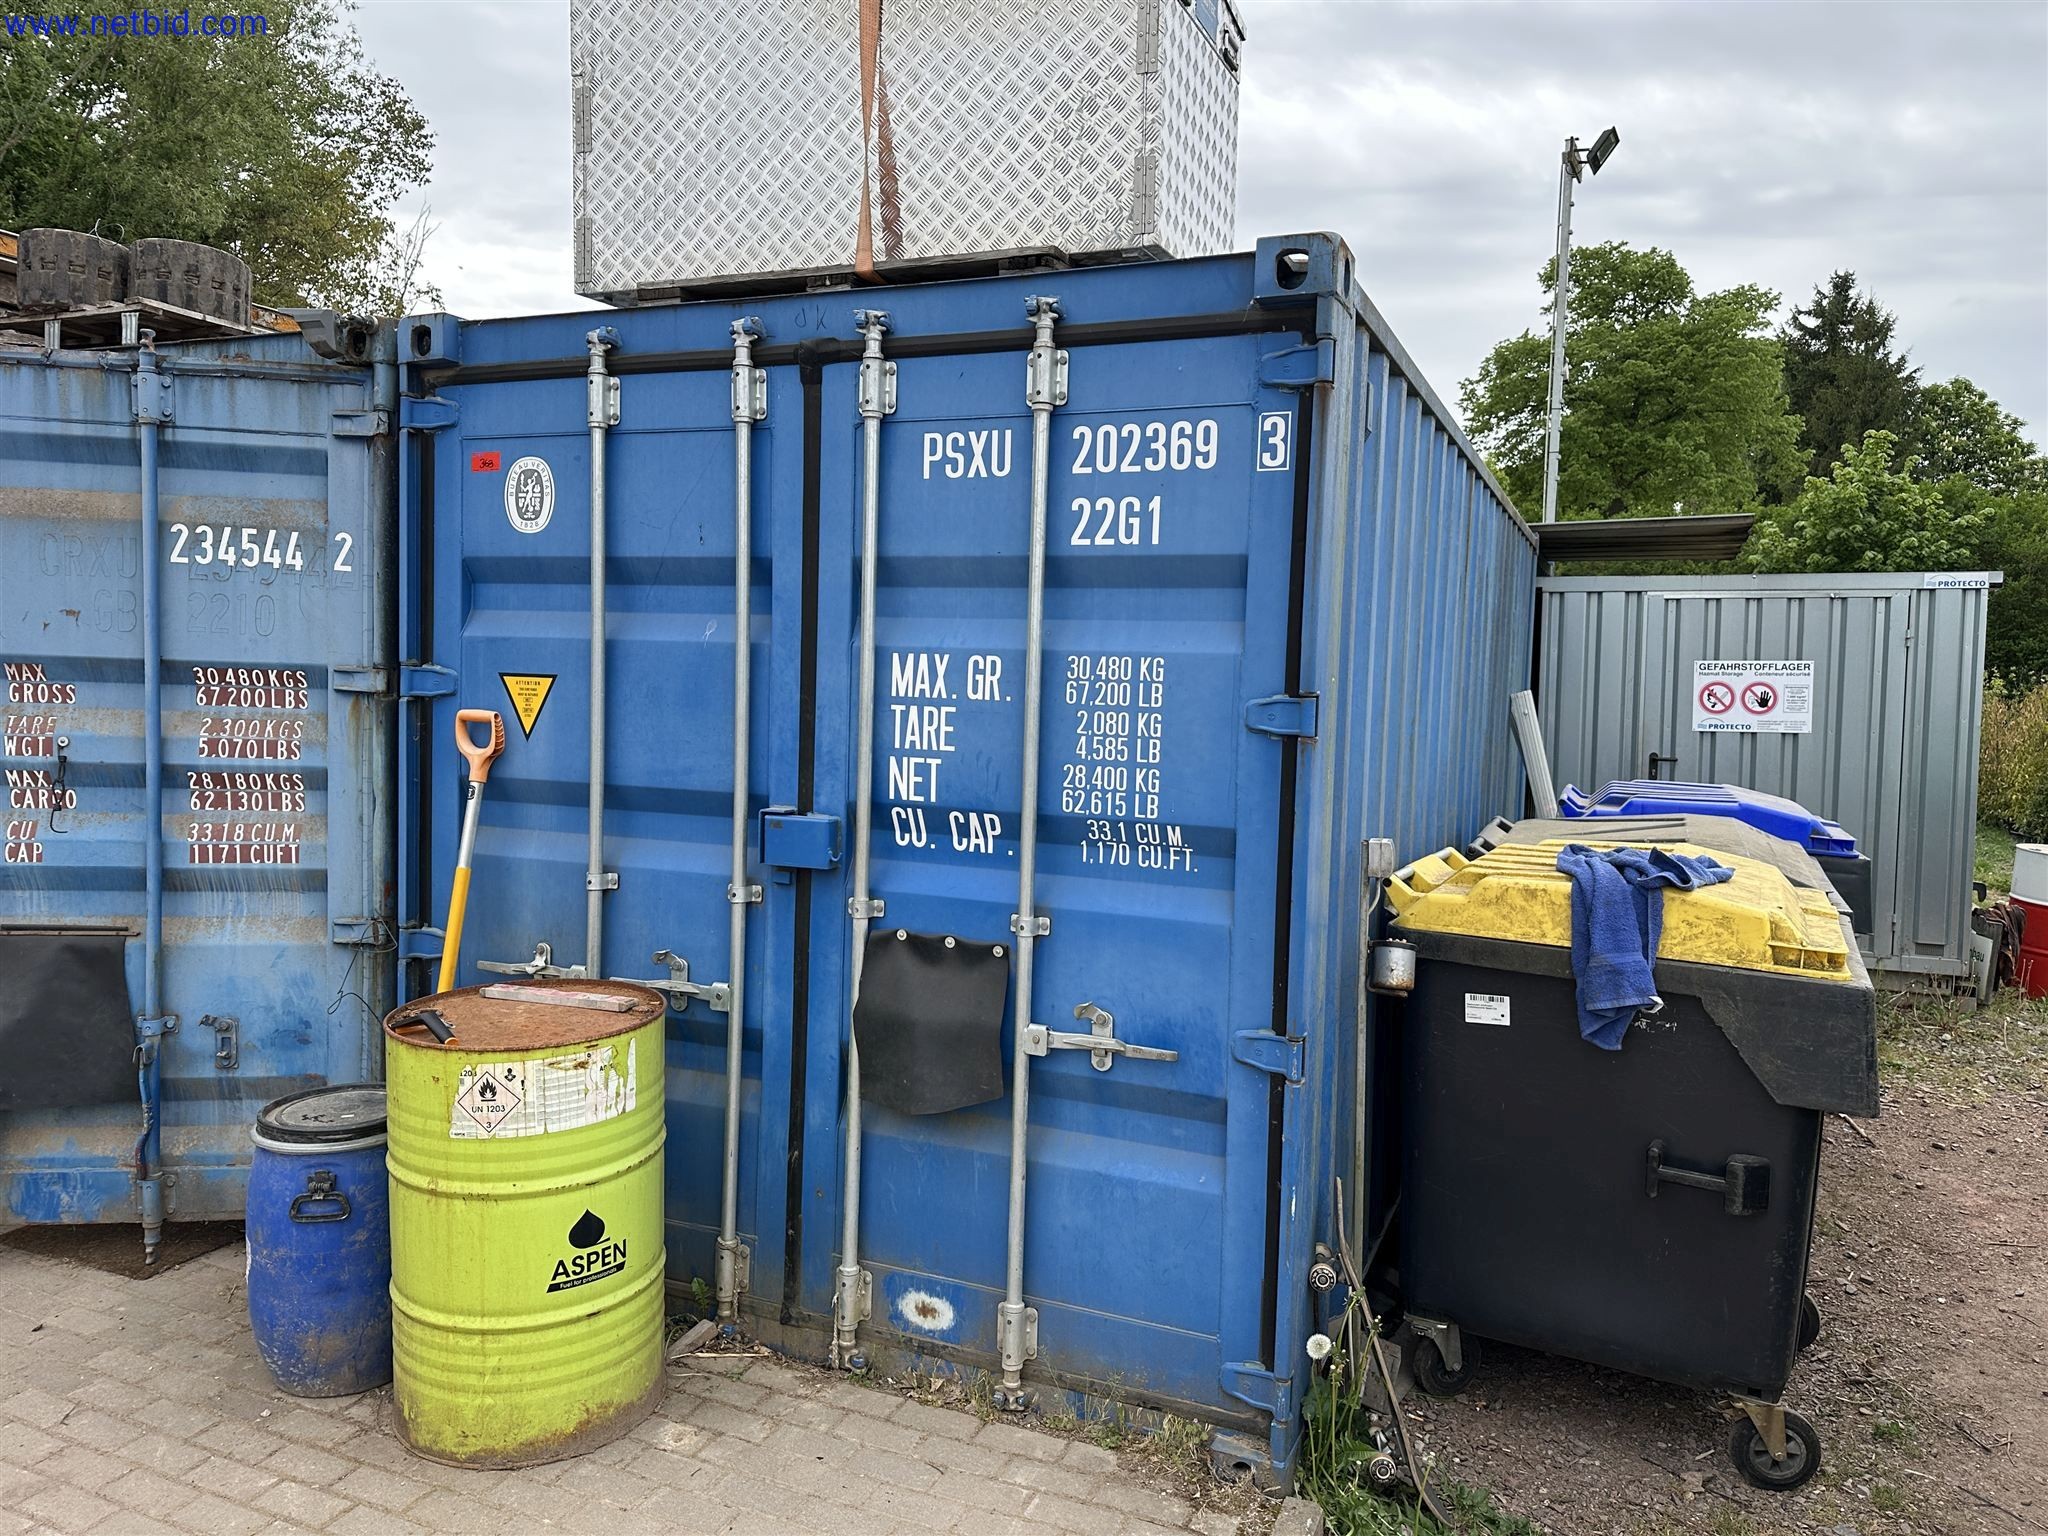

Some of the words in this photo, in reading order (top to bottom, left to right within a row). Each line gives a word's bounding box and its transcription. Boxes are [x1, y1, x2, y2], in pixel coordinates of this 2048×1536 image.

[923, 429, 1012, 479] PSXU
[1071, 419, 1219, 474] 202369
[1261, 416, 1286, 467] 3
[509, 462, 529, 497] BUREAU
[531, 462, 551, 497] VERITAS
[519, 521, 540, 529] 1828
[1070, 495, 1161, 546] 22G1
[170, 523, 303, 571] 234544
[333, 532, 353, 572] 2
[4, 663, 47, 682] MAX
[891, 652, 957, 699] MAX.
[967, 655, 1011, 701] GR.
[1067, 656, 1132, 681] 30,480
[1139, 657, 1165, 682] KG
[1699, 663, 1811, 671] GEFAHRSTOFFLAGER
[9, 683, 76, 704] GROSS
[1065, 681, 1130, 707] 67,200
[1138, 683, 1163, 708] LB
[7, 716, 57, 734] TARE
[891, 705, 956, 751] TARE
[1076, 711, 1129, 736] 2,080
[1137, 712, 1162, 738] KG
[4, 736, 50, 757] WGT.
[1075, 736, 1128, 762] 4,585
[1136, 738, 1161, 763] LB
[5, 769, 53, 788] MAX.
[889, 756, 942, 803] NET
[1063, 765, 1127, 791] 28,400
[1135, 768, 1160, 793] KG
[1062, 790, 1126, 817] 62,615
[1134, 794, 1159, 819] LB
[7, 820, 36, 841] CU.
[187, 823, 244, 843] 33.18
[891, 807, 936, 849] CU.
[949, 811, 1013, 856] CAP.
[1086, 819, 1126, 843] 33.1
[5, 842, 43, 863] CAP
[1080, 840, 1129, 866] 1,170
[487, 1105, 506, 1113] 1203
[486, 1121, 492, 1129] 3
[551, 1239, 627, 1281] ASPEN
[559, 1280, 573, 1289] Fuel
[574, 1278, 582, 1286] for
[583, 1267, 617, 1284] professionals
